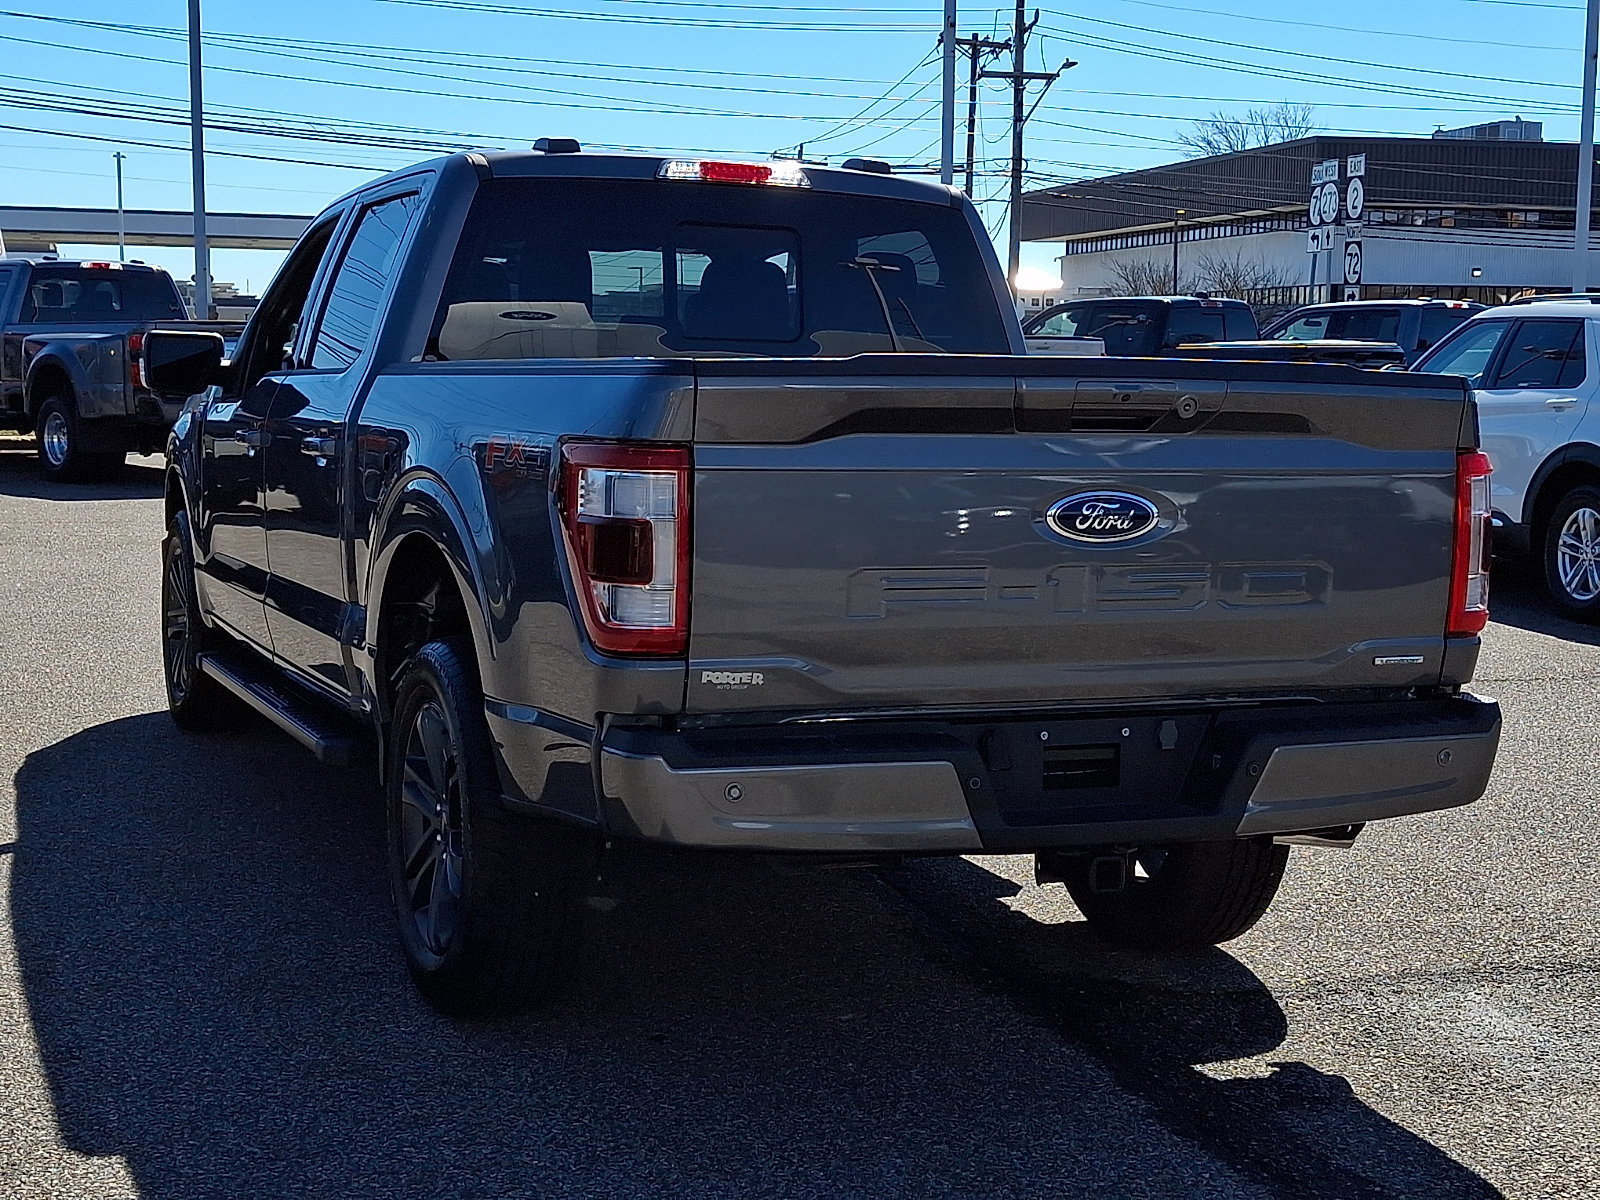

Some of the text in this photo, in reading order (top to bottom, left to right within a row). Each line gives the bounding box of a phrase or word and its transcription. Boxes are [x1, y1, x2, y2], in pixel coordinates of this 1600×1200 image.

[1324, 164, 1337, 178] WEST
[1349, 159, 1362, 174] EAST
[1322, 190, 1337, 215] 273
[1351, 186, 1359, 210] 2
[1347, 252, 1359, 275] 72
[1075, 501, 1135, 530] Ford
[846, 560, 1333, 618] F-150
[701, 671, 764, 685] PORTER
